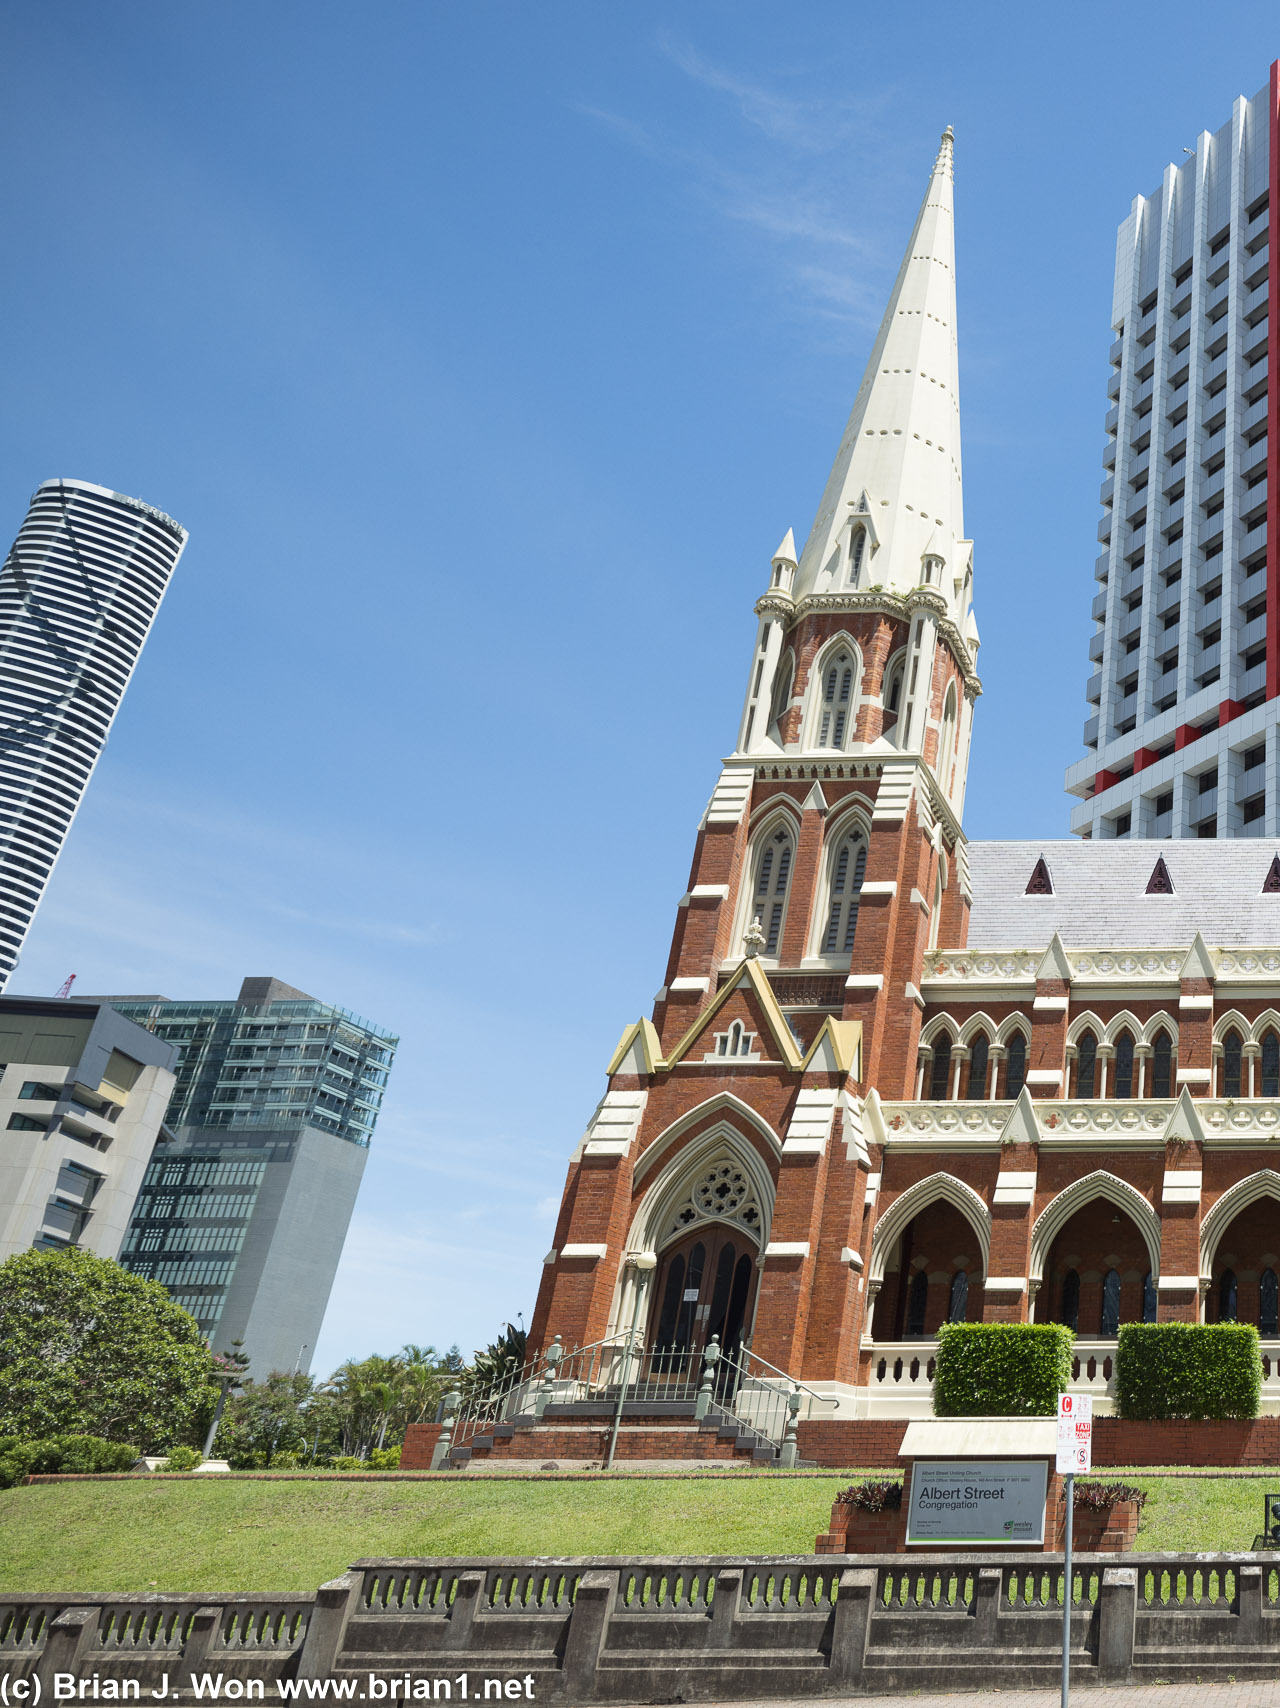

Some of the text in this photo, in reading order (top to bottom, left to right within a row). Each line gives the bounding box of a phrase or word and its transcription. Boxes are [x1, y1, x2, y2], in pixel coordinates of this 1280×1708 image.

[1075, 1431, 1090, 1439] ZONE
[920, 1487, 1005, 1500] Albert Street
[918, 1501, 978, 1511] Congregation
[1013, 1520, 1033, 1528] wesley
